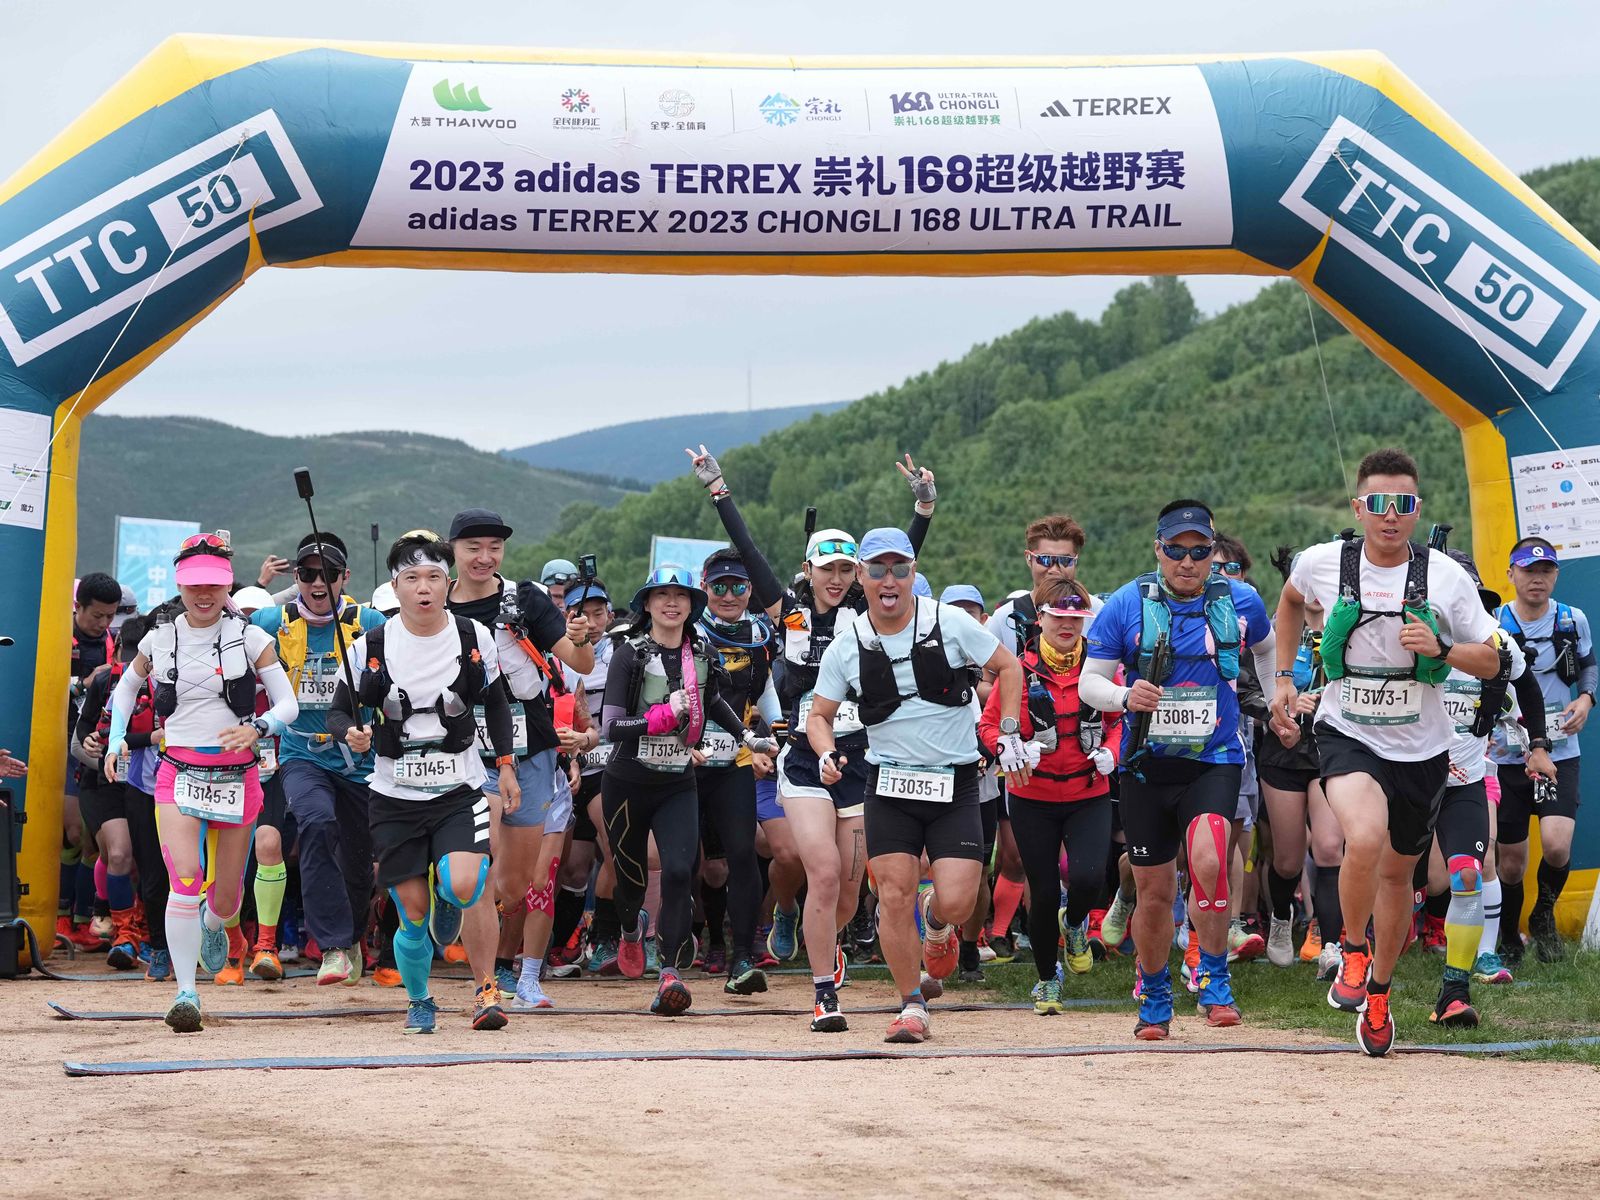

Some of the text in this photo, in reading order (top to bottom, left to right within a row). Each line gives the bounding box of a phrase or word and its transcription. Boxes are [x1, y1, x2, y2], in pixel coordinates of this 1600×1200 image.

[804, 97, 842, 114] 崇礼
[939, 99, 1000, 110] CHONGLI
[1073, 96, 1172, 117] TERREX
[435, 117, 517, 129] THAIWOO
[894, 114, 1001, 126] 崇礼168超级越野赛
[408, 150, 1186, 197] 2023 adidas TERREX 崇礼168超级越野赛
[407, 203, 1182, 234] adidas TERREX 2023 CHONGLI 168 ULTRA TRAIL
[14, 174, 242, 314] TTC 50
[1338, 159, 1535, 322] TTC 50
[1372, 591, 1394, 599] TERREX
[1352, 687, 1409, 706] T3173-1
[1156, 709, 1210, 725] T3081-2
[405, 758, 456, 778] T3145-1
[186, 783, 237, 805] T3145-3
[890, 777, 945, 797] T3035-1
